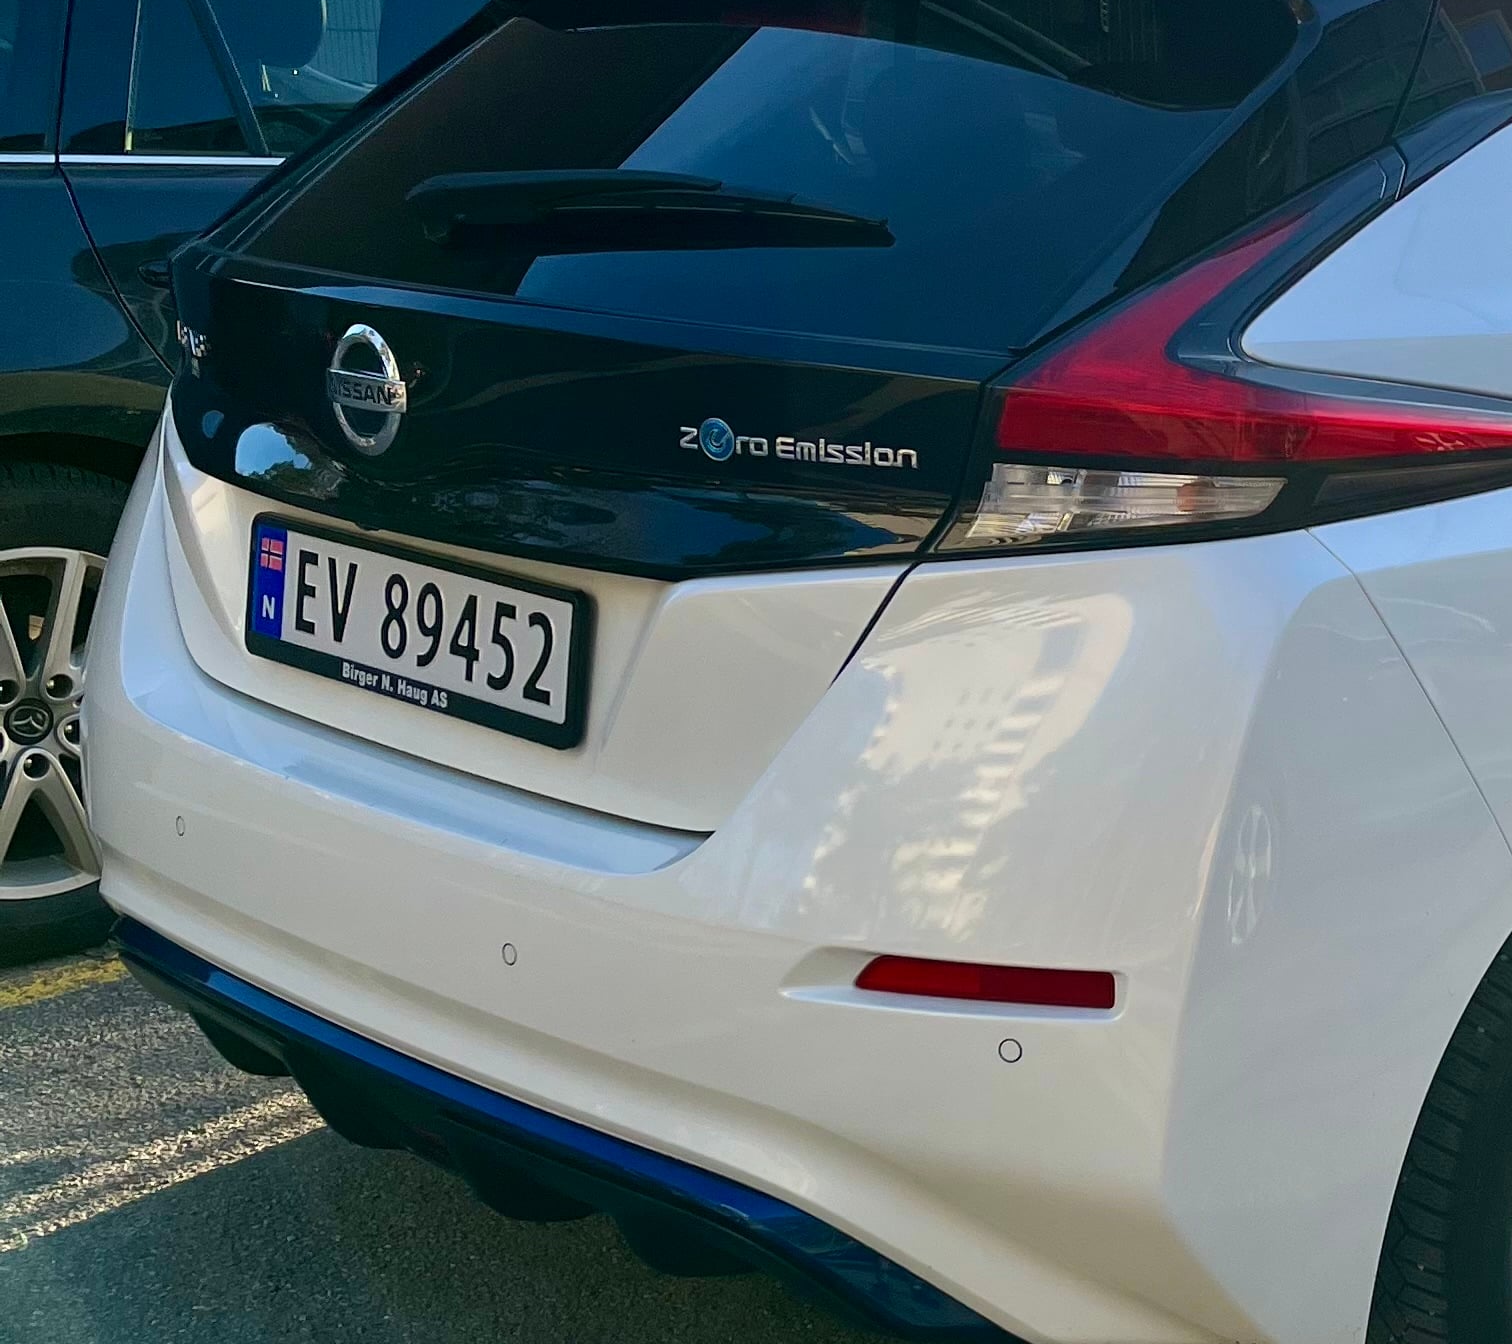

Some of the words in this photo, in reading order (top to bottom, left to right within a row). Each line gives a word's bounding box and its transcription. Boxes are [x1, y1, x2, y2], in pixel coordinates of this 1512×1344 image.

[261, 594, 276, 620] N
[294, 549, 358, 643] EV
[380, 573, 554, 706] 89452
[342, 661, 378, 686] Birger
[381, 674, 394, 692] N.
[397, 679, 428, 705] Haug
[431, 690, 448, 708] AS
